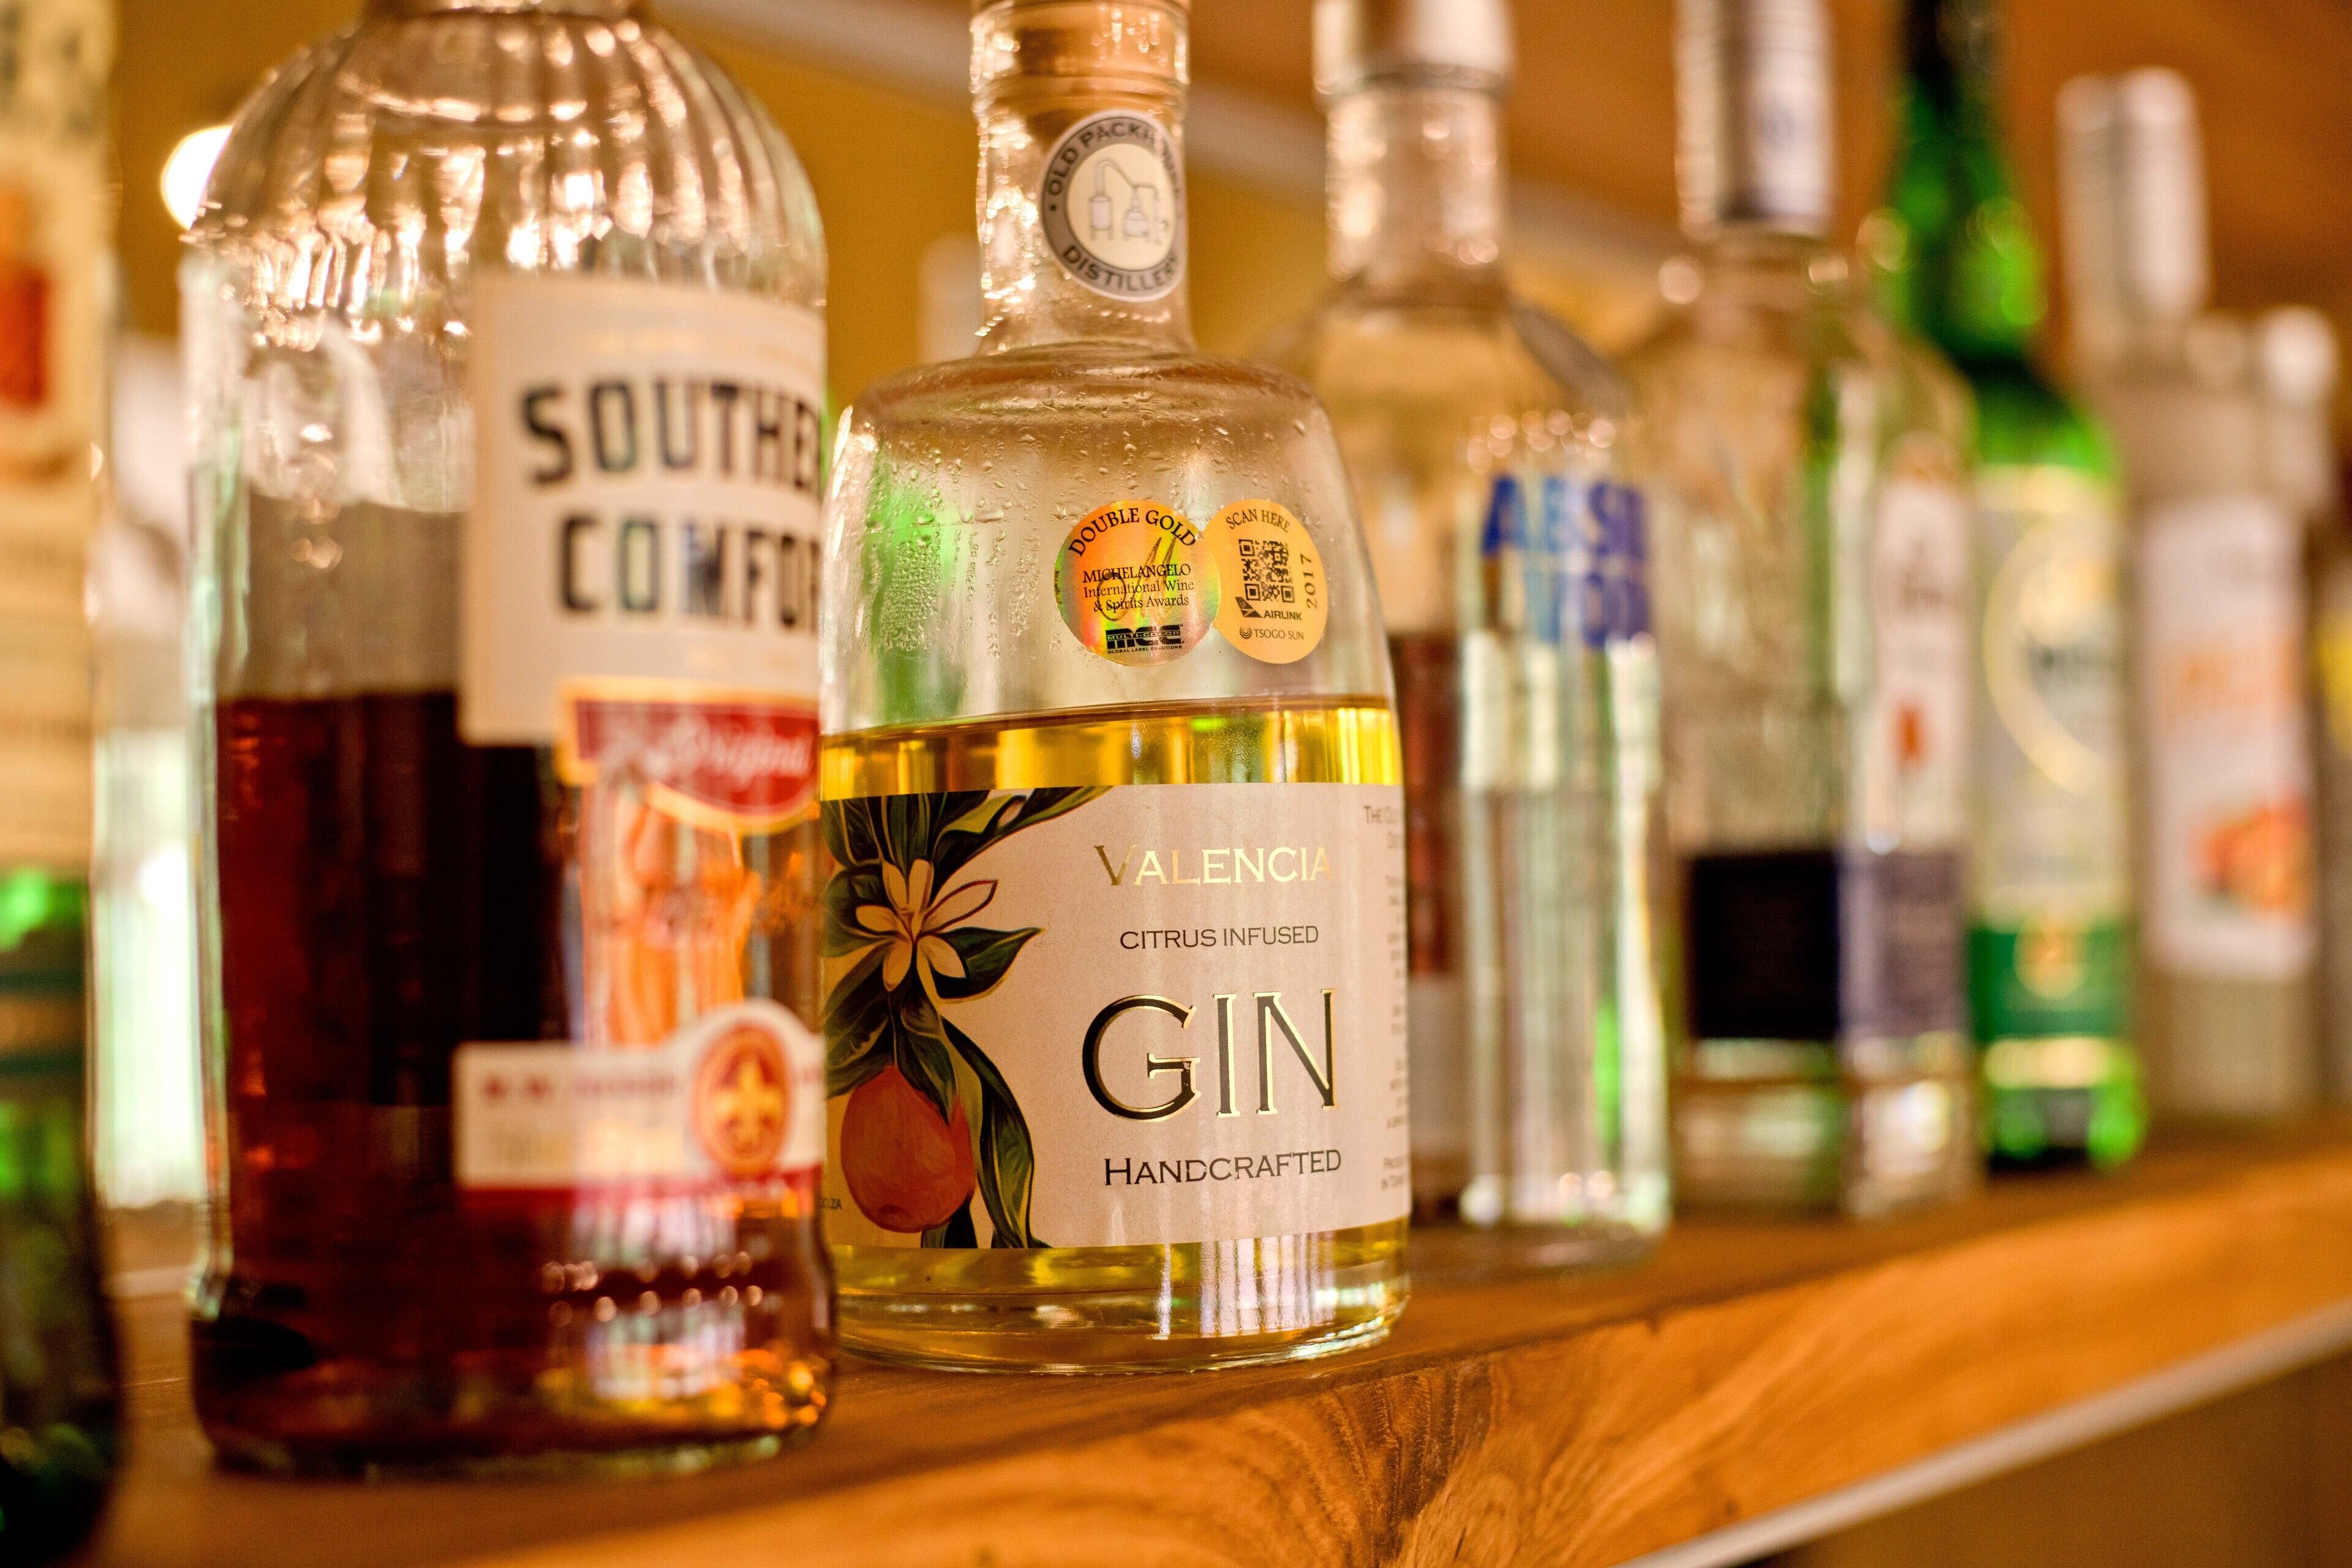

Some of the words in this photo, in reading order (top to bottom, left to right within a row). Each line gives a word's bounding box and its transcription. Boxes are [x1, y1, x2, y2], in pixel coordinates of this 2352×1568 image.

[1049, 148, 1078, 194] OLD
[1068, 507, 1140, 557] DOUBLE
[1145, 510, 1196, 546] GOLD
[1226, 509, 1257, 529] SCAN
[1261, 510, 1290, 533] HERE
[1082, 563, 1191, 584] MICHELANGELO
[1300, 553, 1318, 609] 2017
[1084, 579, 1161, 598] International
[1163, 579, 1195, 592] Wine
[1093, 600, 1102, 612] &
[1106, 597, 1144, 613] Spirits
[1145, 594, 1189, 608] Awards
[1264, 610, 1302, 620] AIRLINK
[1254, 628, 1286, 639] TSOGO
[1288, 631, 1304, 639] SUN
[1094, 845, 1333, 886] VALENCIA
[1120, 929, 1217, 950] CITRUS
[1222, 925, 1319, 946] INFUSED
[1082, 988, 1340, 1123] GIN
[1104, 1148, 1342, 1186] HANDCRAFTED
